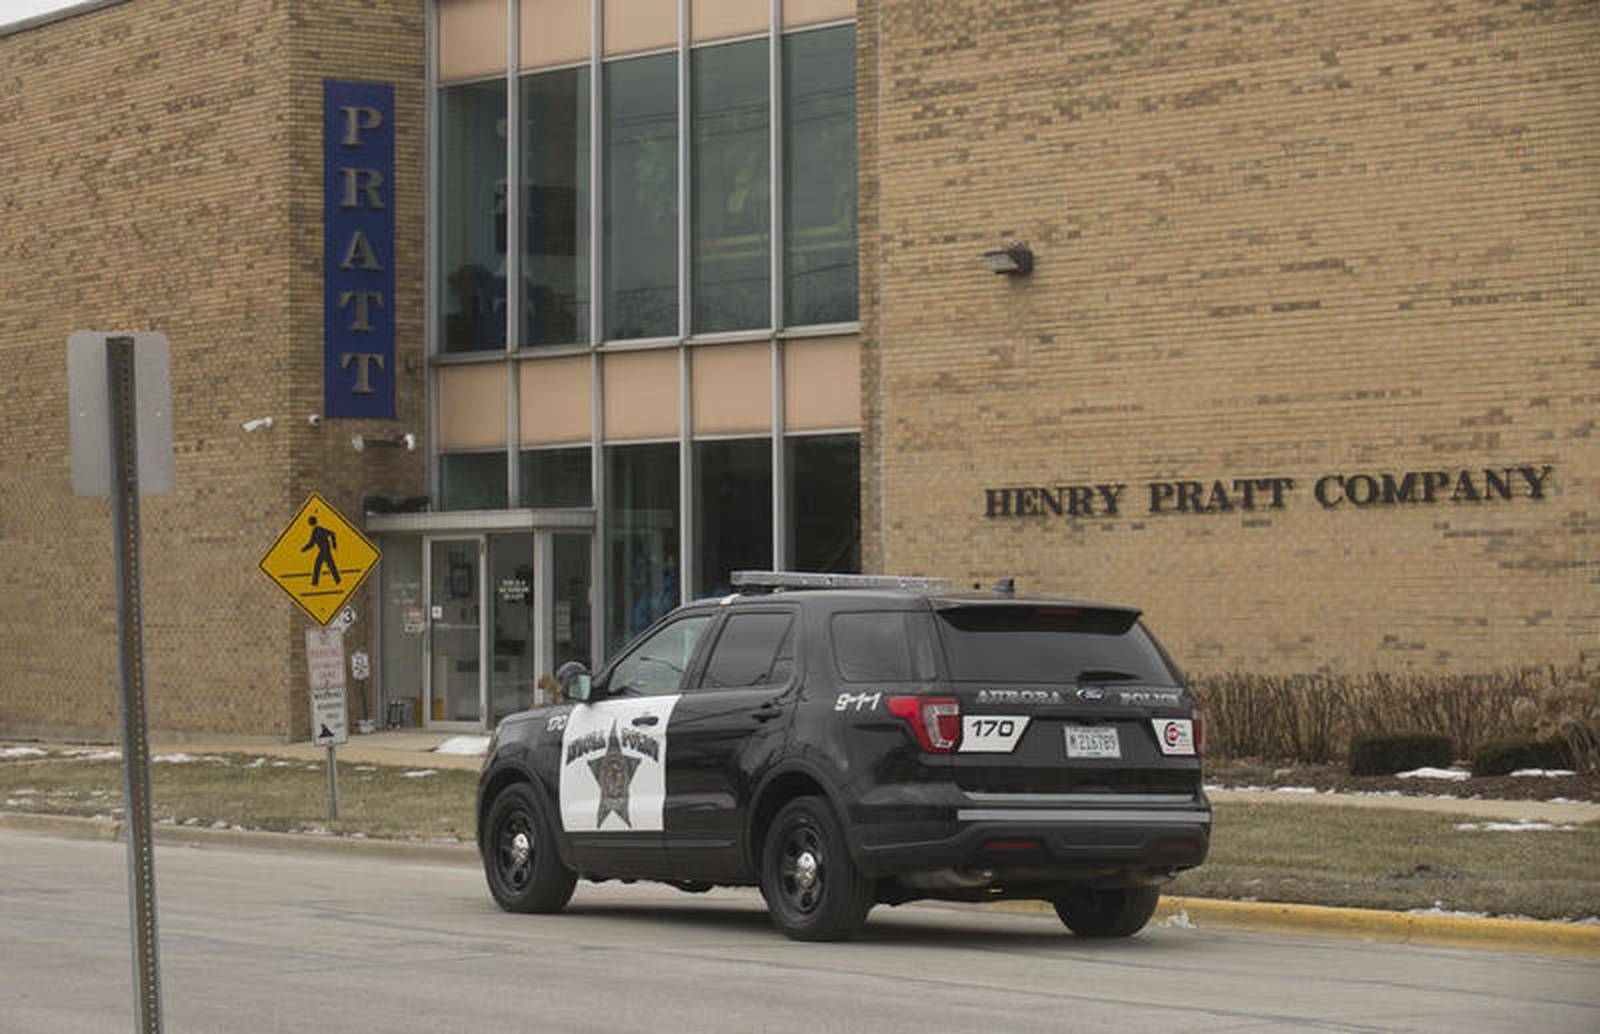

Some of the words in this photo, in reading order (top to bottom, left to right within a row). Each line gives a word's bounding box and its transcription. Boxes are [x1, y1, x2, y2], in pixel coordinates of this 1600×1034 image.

[338, 105, 385, 396] PRATT
[984, 482, 1126, 518] HENRY
[1148, 476, 1294, 514] PRATT
[1313, 464, 1552, 510] COMPANY
[976, 689, 1062, 704] AURORA
[1119, 690, 1182, 705] POLICE
[971, 719, 1015, 738] 170
